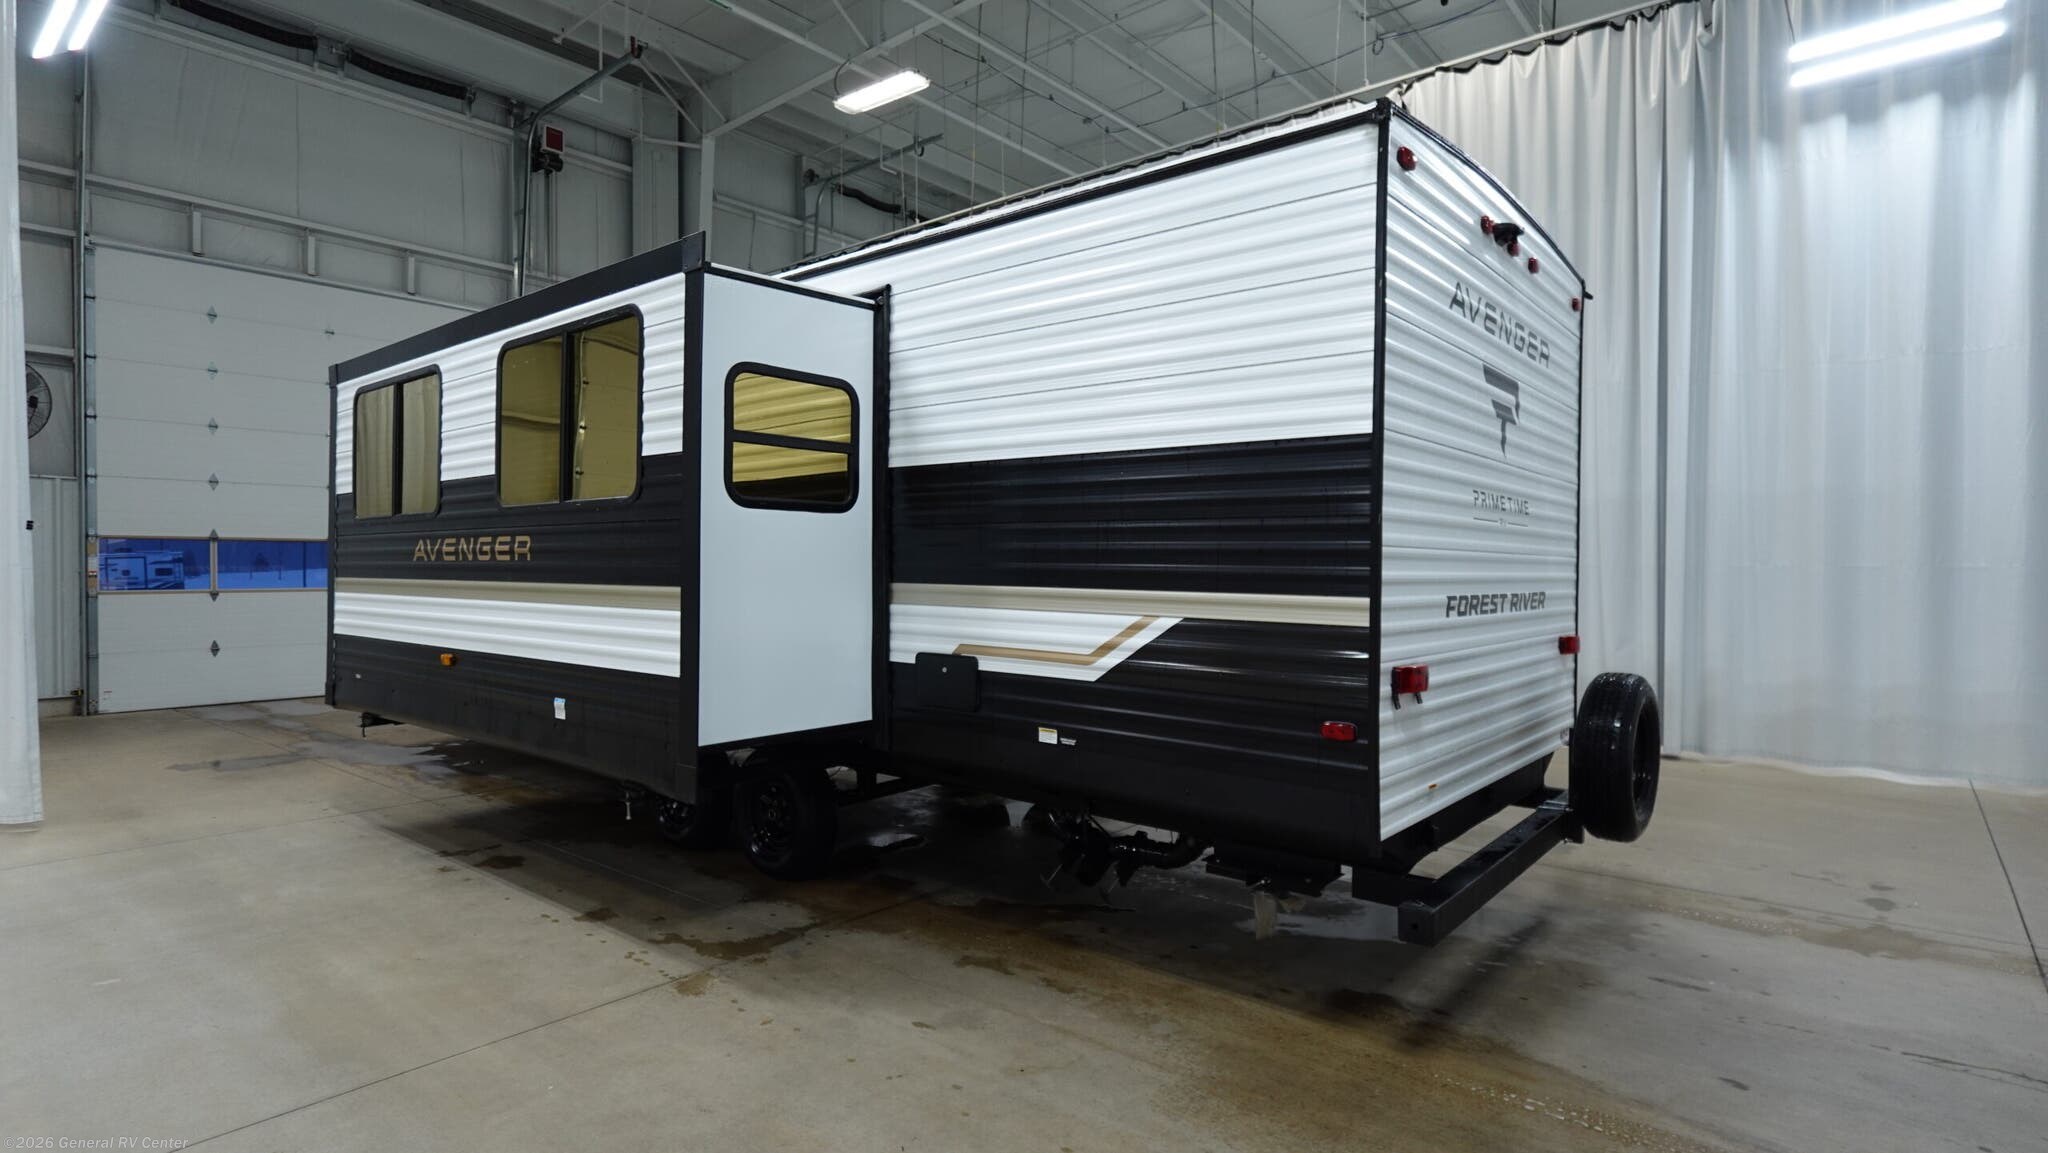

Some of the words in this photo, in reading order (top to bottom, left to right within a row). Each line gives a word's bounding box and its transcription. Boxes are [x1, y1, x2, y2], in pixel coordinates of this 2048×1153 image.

[1449, 281, 1550, 368] AVENGER
[413, 535, 531, 561] AVENGER
[1445, 593, 1508, 618] FOREST
[1509, 591, 1546, 613] RIVER
